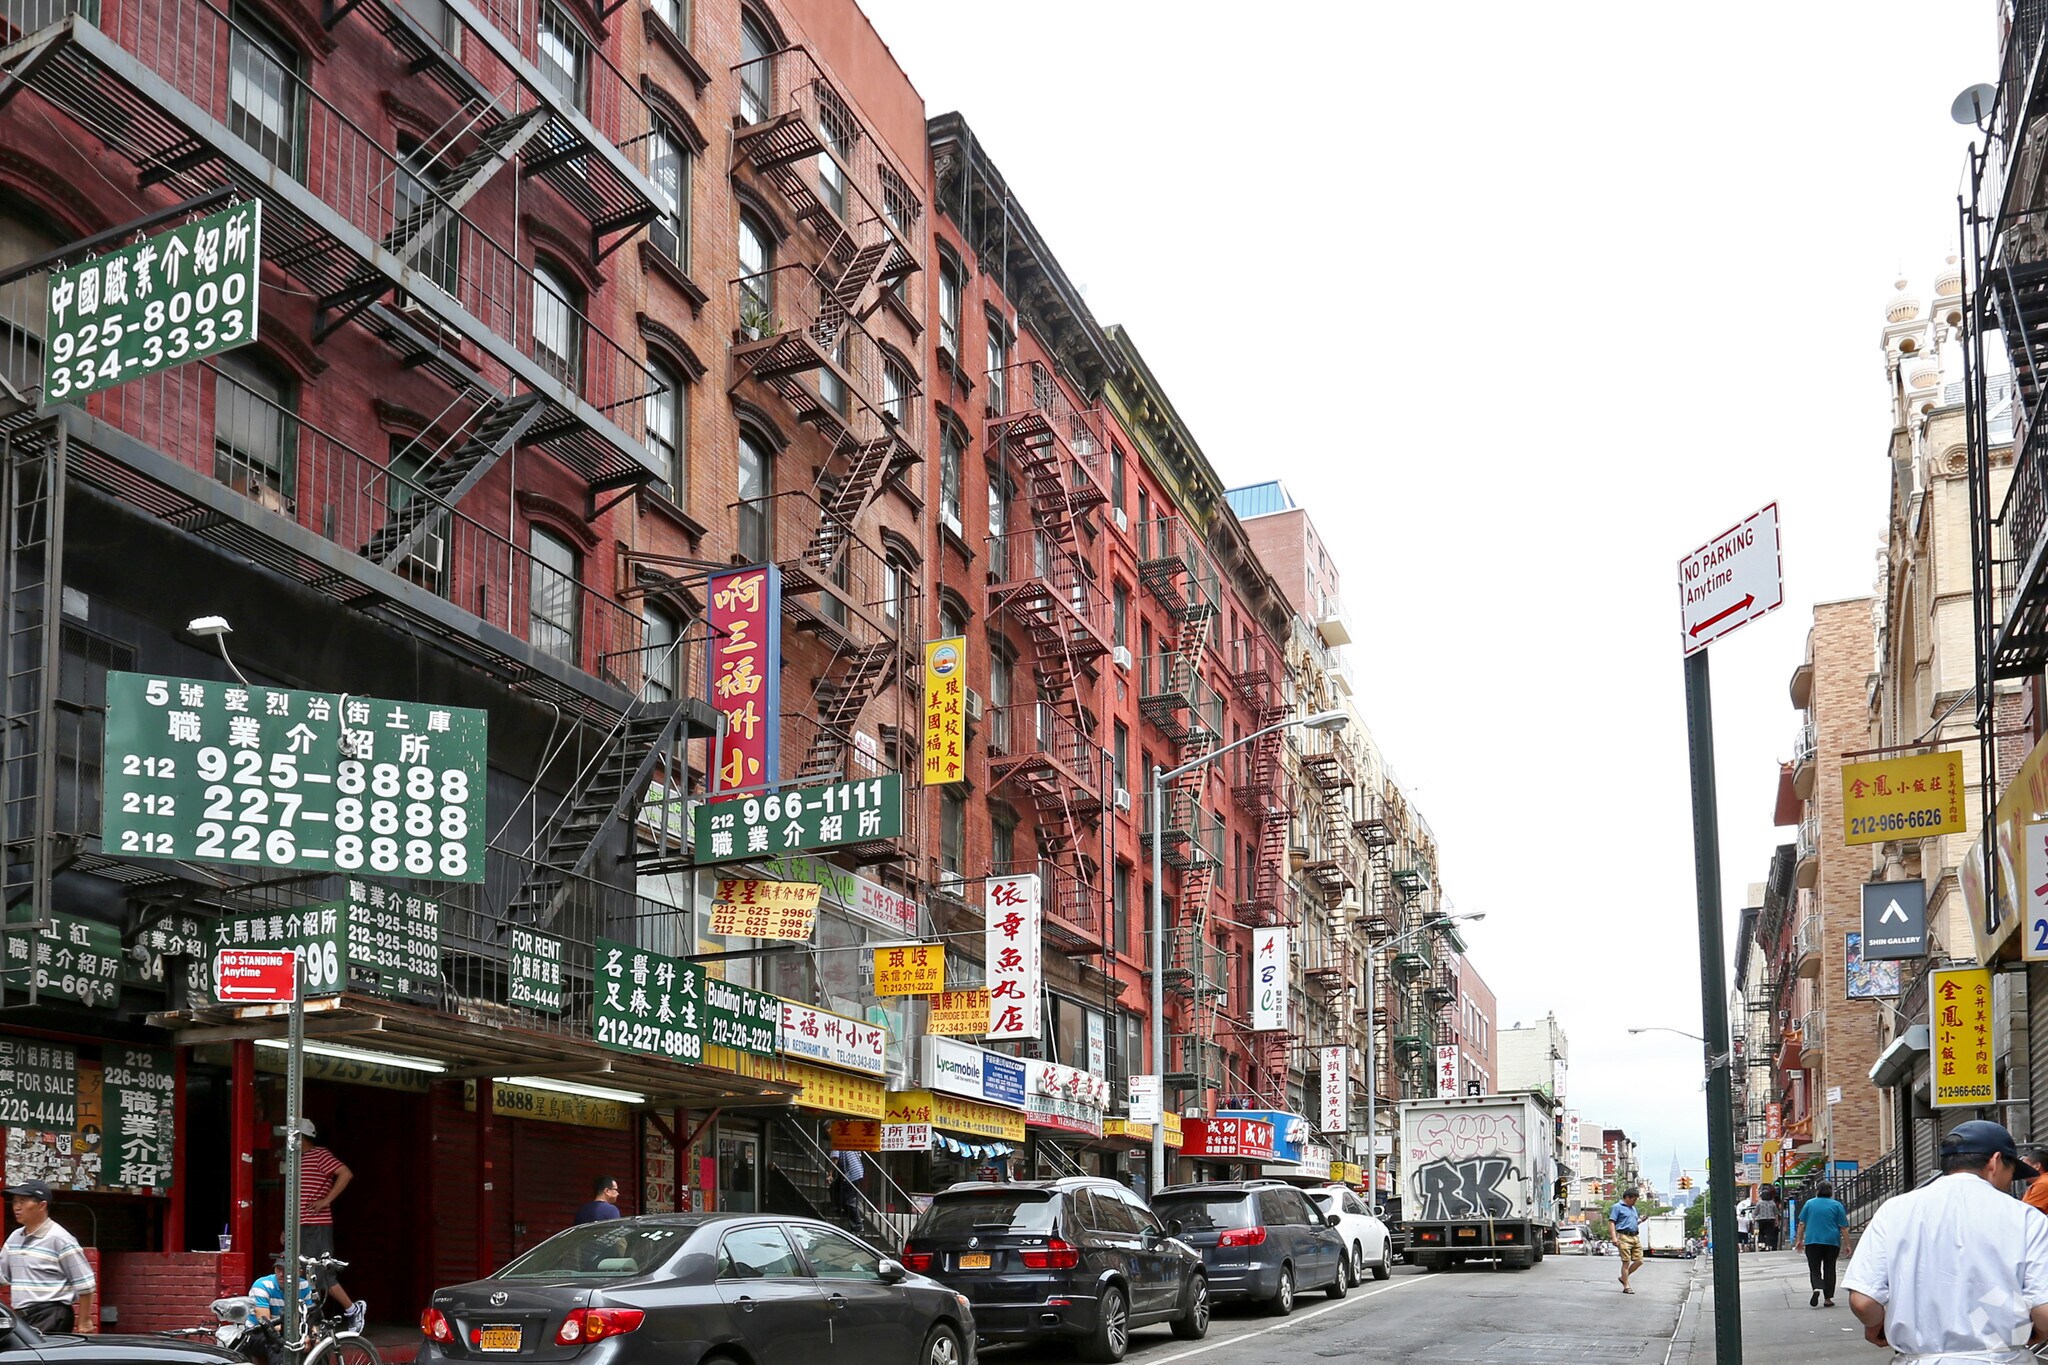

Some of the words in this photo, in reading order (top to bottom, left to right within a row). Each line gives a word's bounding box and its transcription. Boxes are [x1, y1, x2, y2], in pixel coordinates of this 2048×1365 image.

[51, 210, 251, 329] 中國職業介紹所
[52, 272, 247, 365] 925-8000
[50, 309, 244, 398] 334-3333
[1685, 561, 1700, 584] NO
[1703, 527, 1754, 573] PARKING
[1687, 568, 1733, 606] Anytime
[713, 573, 765, 801] 啊三福州小
[167, 710, 431, 766] 職業介紹所
[927, 690, 943, 773] 美國福州
[122, 754, 176, 779] 212
[196, 746, 469, 804] 925-8888
[122, 792, 176, 817] 212
[203, 784, 469, 840] 227-8888
[711, 813, 735, 830] 212
[743, 779, 883, 825] 966-1111
[1851, 808, 1942, 835] 212-966-6626
[121, 829, 175, 855] 212
[195, 821, 469, 877] 226-8888
[710, 808, 881, 858] 職業介紹所
[349, 879, 439, 925] 職業介紹所
[718, 879, 759, 905] 星星
[215, 908, 337, 946] 大馬職業介紹所
[348, 924, 438, 960] 212-925-8000
[349, 904, 438, 942] 212-925-5555
[1868, 938, 1886, 946] SHIN
[1887, 936, 1921, 945] GALLERY
[223, 955, 236, 967] NO
[239, 955, 283, 967] STANDING
[348, 942, 438, 978] 212-334-3333
[511, 929, 532, 953] FOR
[535, 936, 561, 961] RENT
[991, 881, 1029, 1033] 依章魚丸店
[224, 967, 261, 979] Anytime
[511, 953, 560, 985] 介紹所招租
[601, 948, 698, 999] 名醫針灸
[883, 984, 889, 993] T:
[891, 982, 934, 992] 212-571-2222
[511, 982, 560, 1009] 226-4444
[602, 981, 699, 1030] 足療養生
[708, 981, 740, 1018] Building
[742, 987, 757, 1017] For
[759, 996, 777, 1023] Sale
[711, 1016, 772, 1053] 212-226-2222
[929, 1021, 988, 1033] 212-343-1999
[934, 1011, 960, 1021] ELDRIDGE
[1938, 979, 1963, 1076] 金鳳小飯莊
[598, 1015, 700, 1059] 212-227-8888
[793, 1038, 820, 1057] RESTAURANT
[15, 1043, 75, 1071] 介紹所招租
[125, 1051, 153, 1068] 212
[936, 1054, 980, 1078] Lycamobile
[17, 1072, 41, 1092] FOR
[44, 1075, 75, 1096] SALE
[1938, 1085, 1991, 1098] 212-966-6626
[0, 1097, 75, 1127] 226-4444
